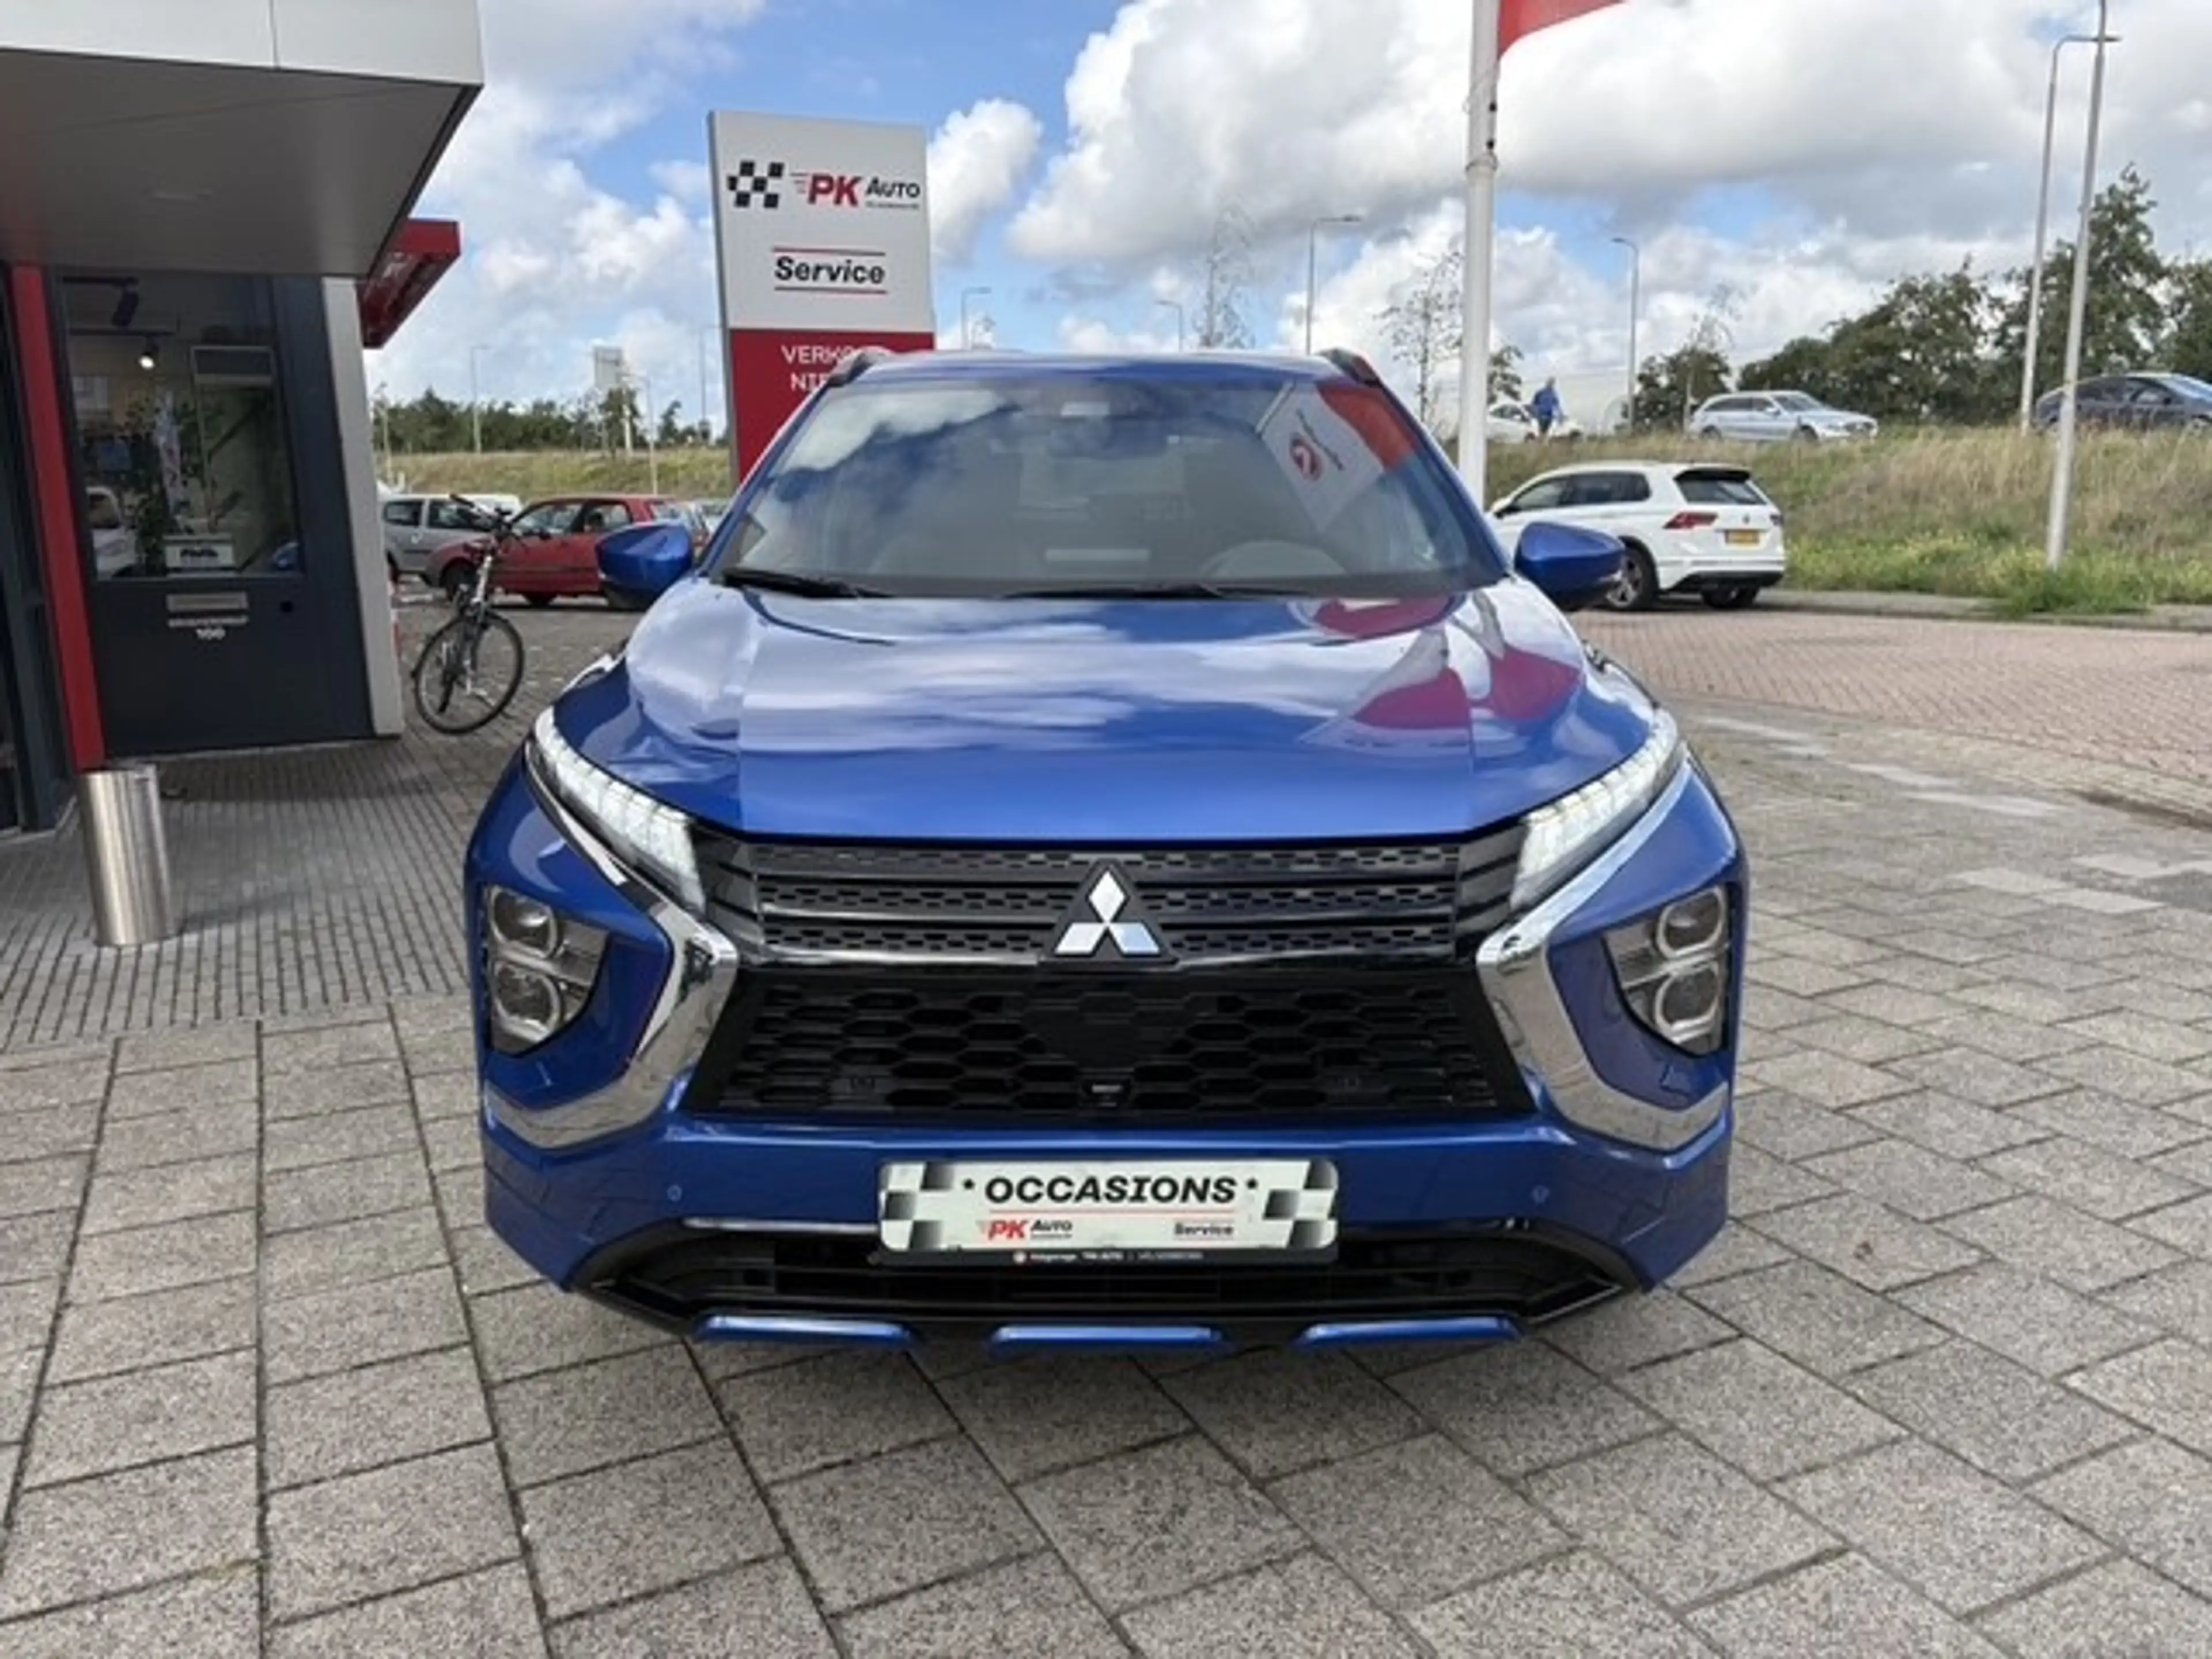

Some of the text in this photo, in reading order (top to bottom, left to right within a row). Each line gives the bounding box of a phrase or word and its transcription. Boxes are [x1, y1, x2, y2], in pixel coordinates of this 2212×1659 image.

[808, 174, 862, 207] PK
[774, 256, 885, 285] Service
[984, 1176, 1238, 1204] OCCASIONS
[988, 1219, 1028, 1240] PK
[1173, 1222, 1234, 1236] Service
